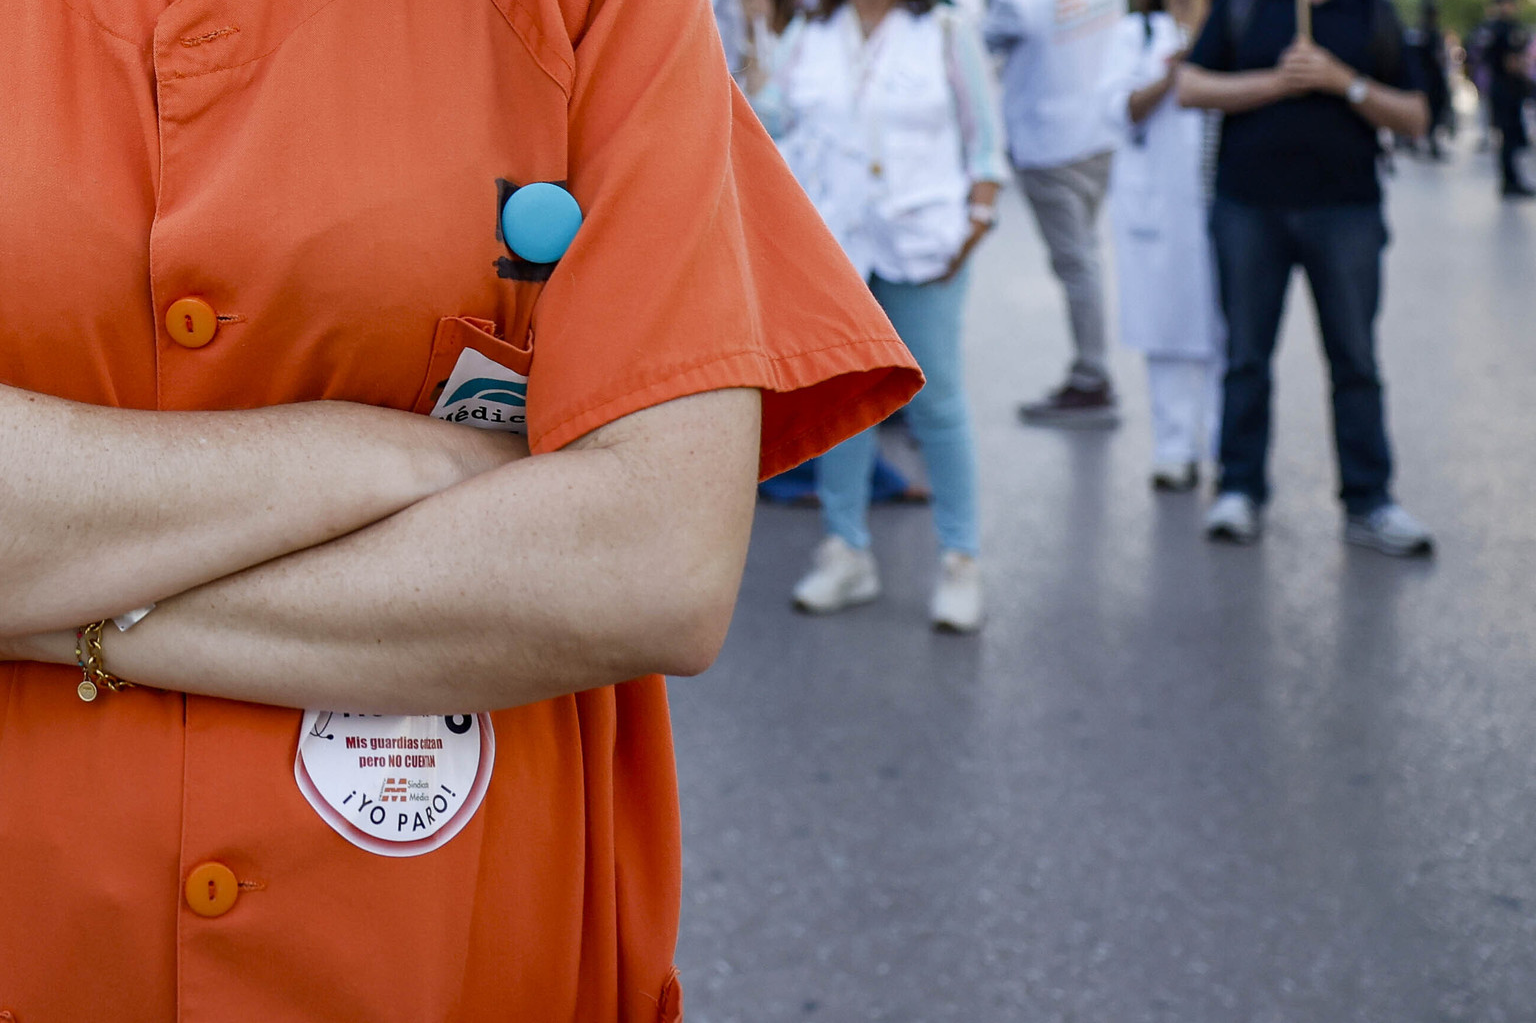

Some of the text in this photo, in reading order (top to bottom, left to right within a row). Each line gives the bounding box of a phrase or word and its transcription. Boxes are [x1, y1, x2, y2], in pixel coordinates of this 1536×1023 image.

[345, 736, 367, 749] Mis
[370, 736, 419, 750] guardias
[359, 755, 385, 768] pero
[388, 754, 402, 768] NO
[342, 790, 386, 825] ¡YO
[397, 784, 456, 832] PARO!
